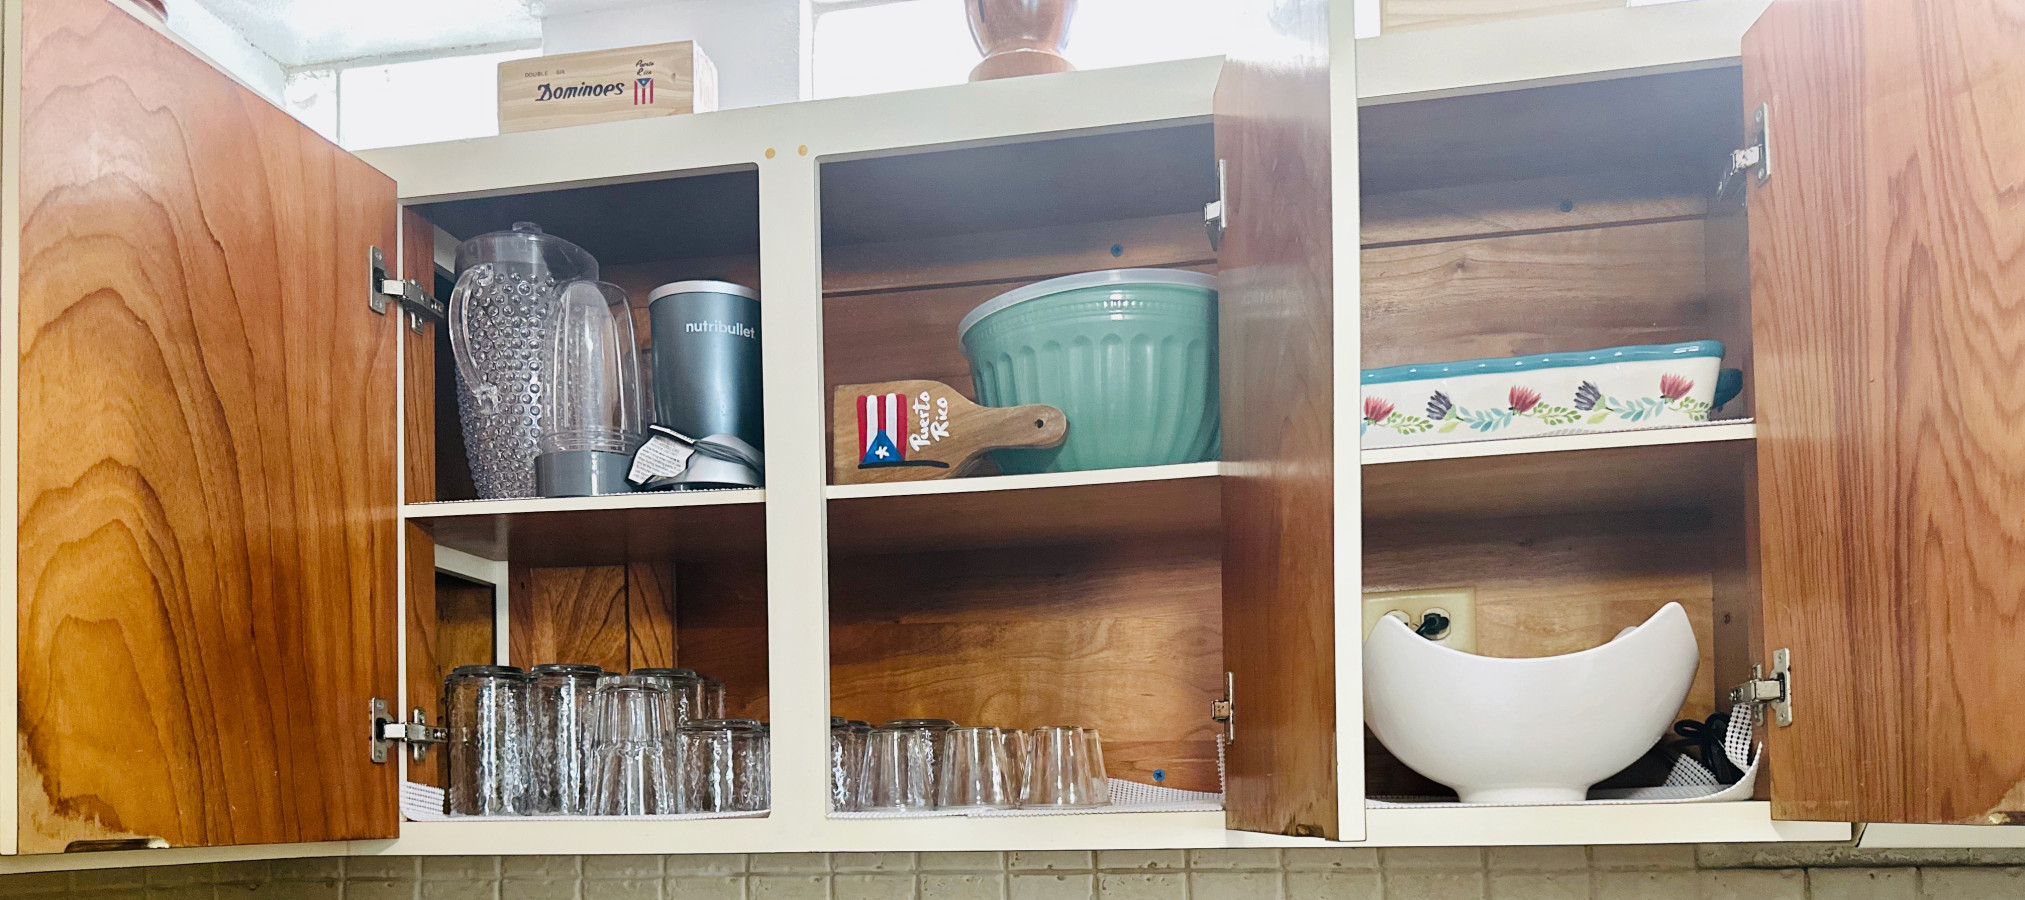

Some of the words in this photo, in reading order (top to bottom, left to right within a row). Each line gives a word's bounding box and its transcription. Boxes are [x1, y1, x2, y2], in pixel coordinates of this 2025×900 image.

[524, 70, 549, 78] DOUBLE
[535, 81, 625, 102] Dominoes
[685, 320, 755, 339] nutribullet
[909, 391, 931, 452] Puerto
[930, 396, 950, 442] Rico
